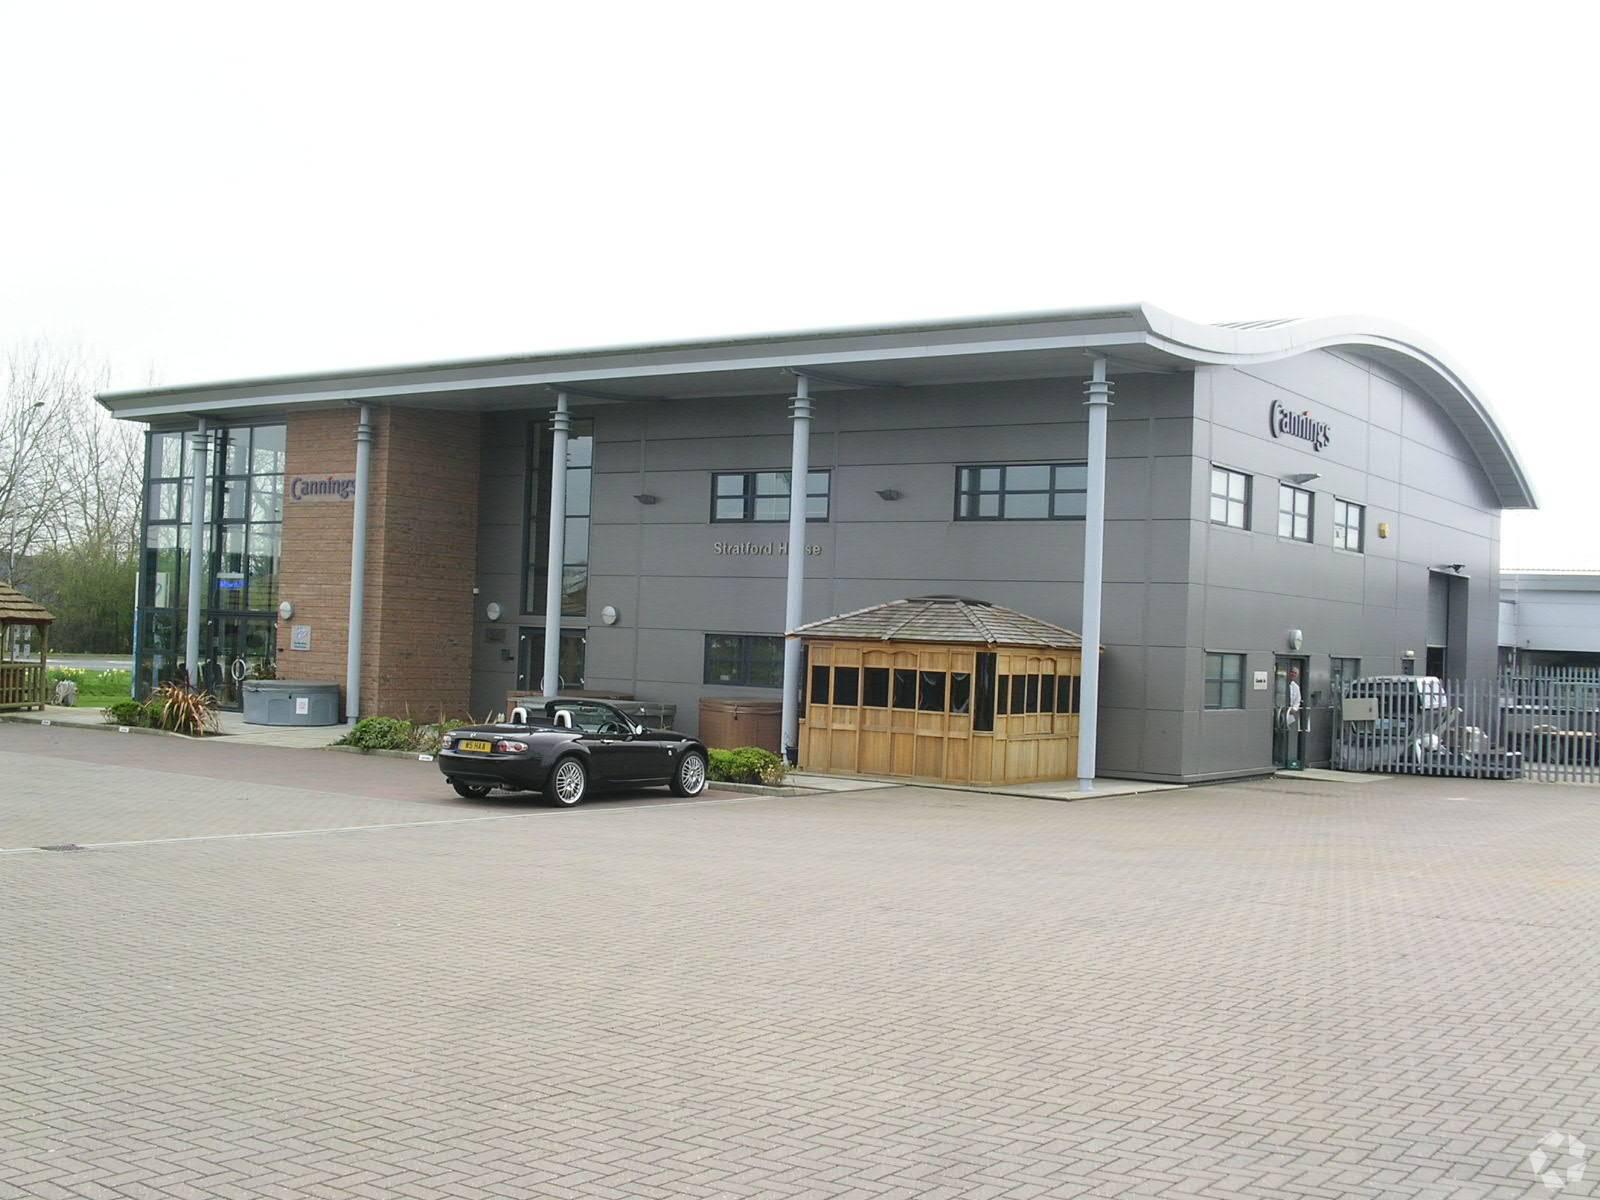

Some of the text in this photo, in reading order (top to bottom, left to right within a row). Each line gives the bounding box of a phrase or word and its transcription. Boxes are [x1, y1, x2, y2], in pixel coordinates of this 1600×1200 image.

[1269, 399, 1330, 452] Cannings
[714, 541, 822, 555] Stratford Hse
